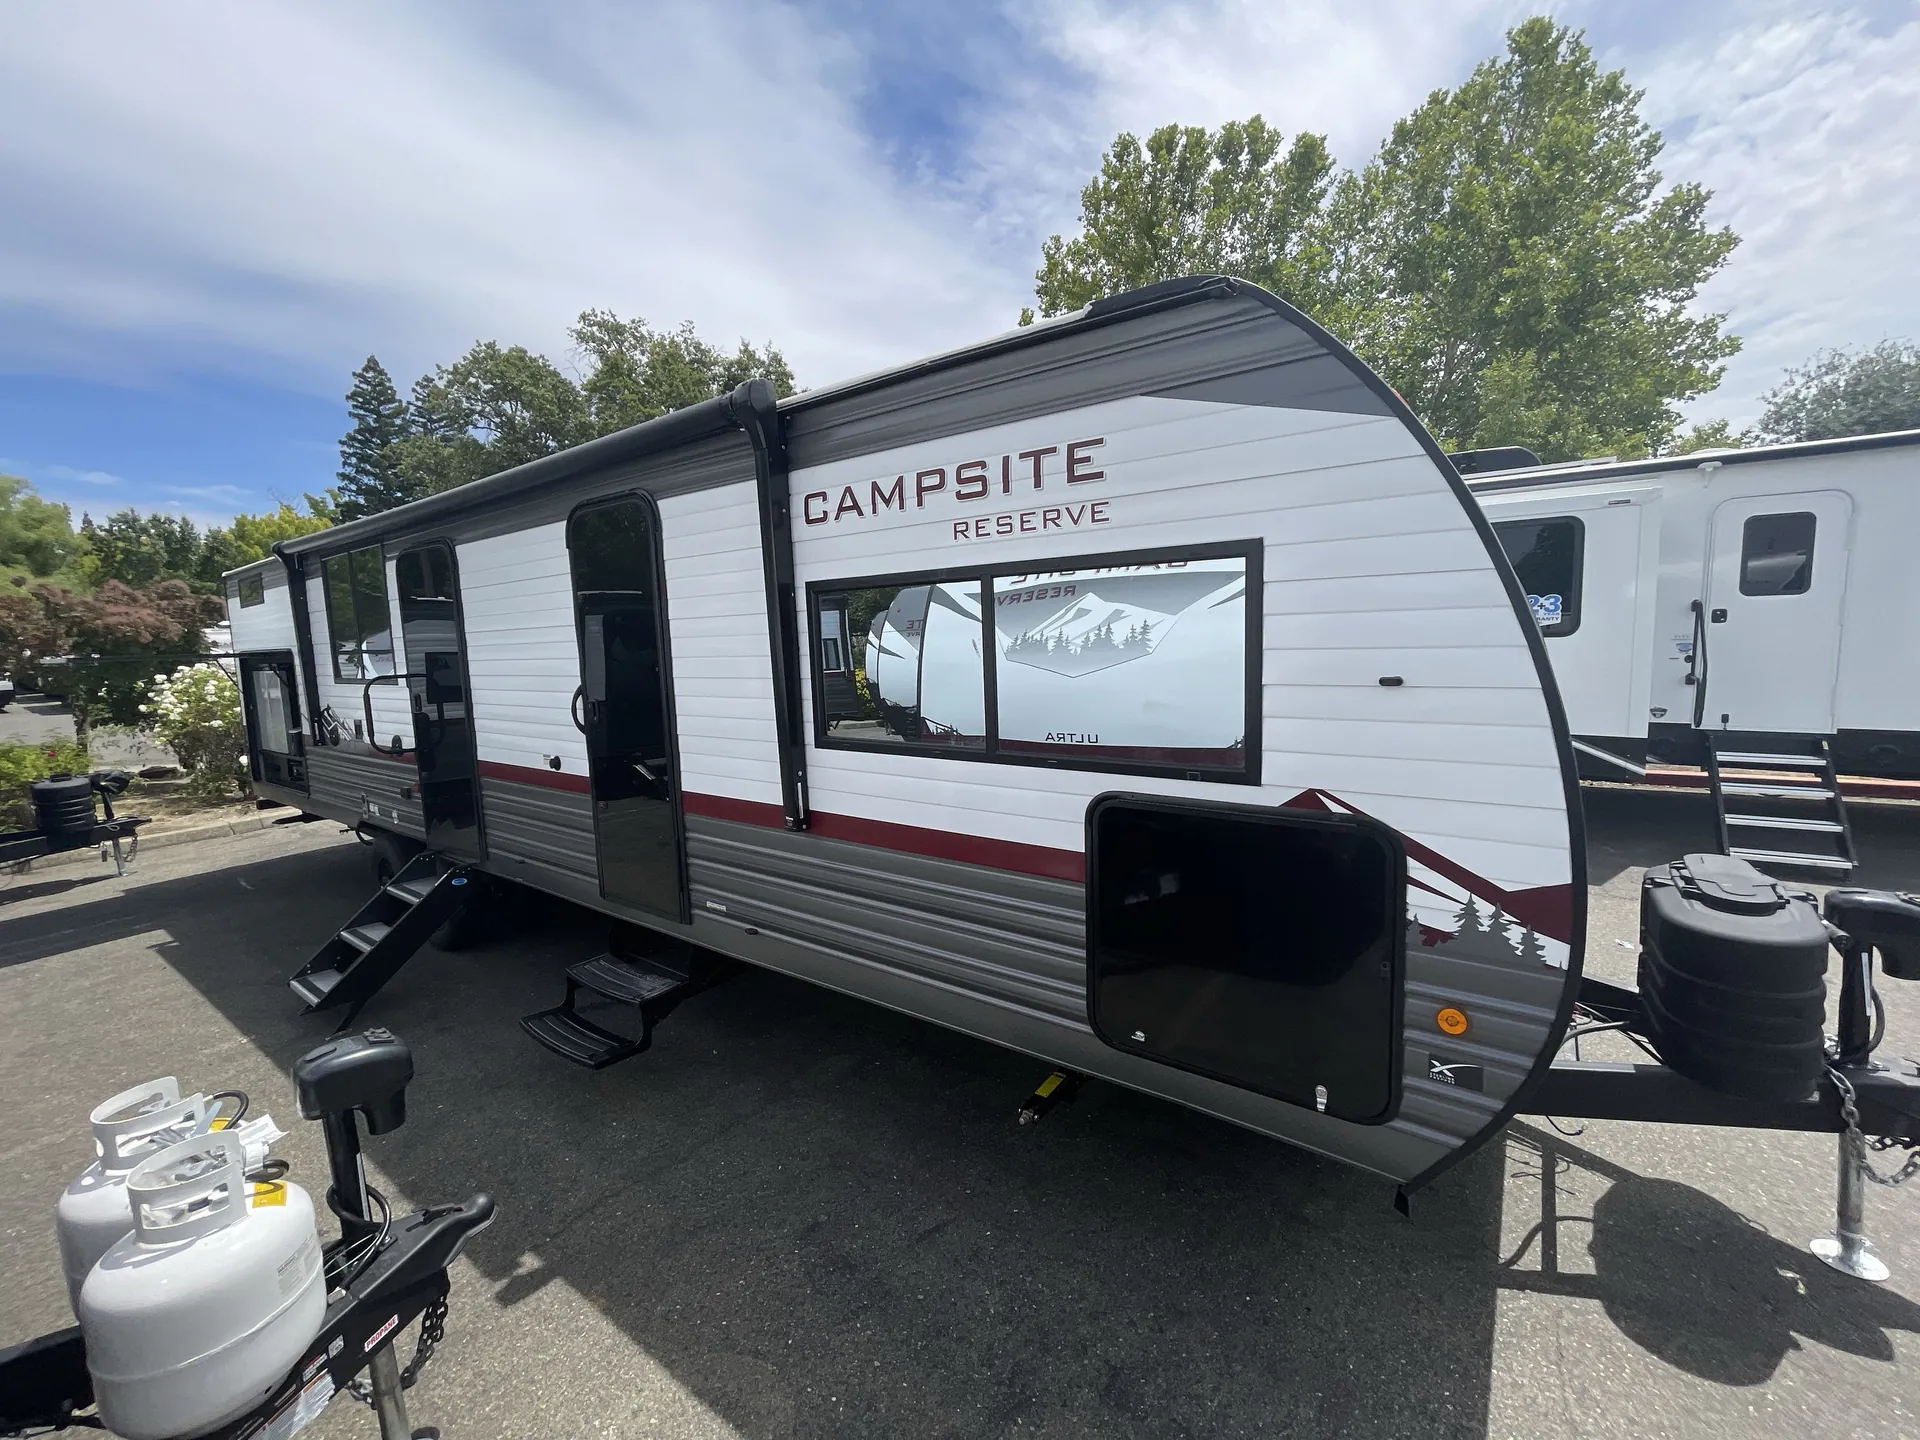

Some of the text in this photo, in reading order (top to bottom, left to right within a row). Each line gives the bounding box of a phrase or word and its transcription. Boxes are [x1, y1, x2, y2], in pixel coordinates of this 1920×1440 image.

[804, 437, 1105, 525] CAMPSITE
[953, 501, 1111, 541] RESERVE
[366, 1316, 397, 1349] PROPANE
